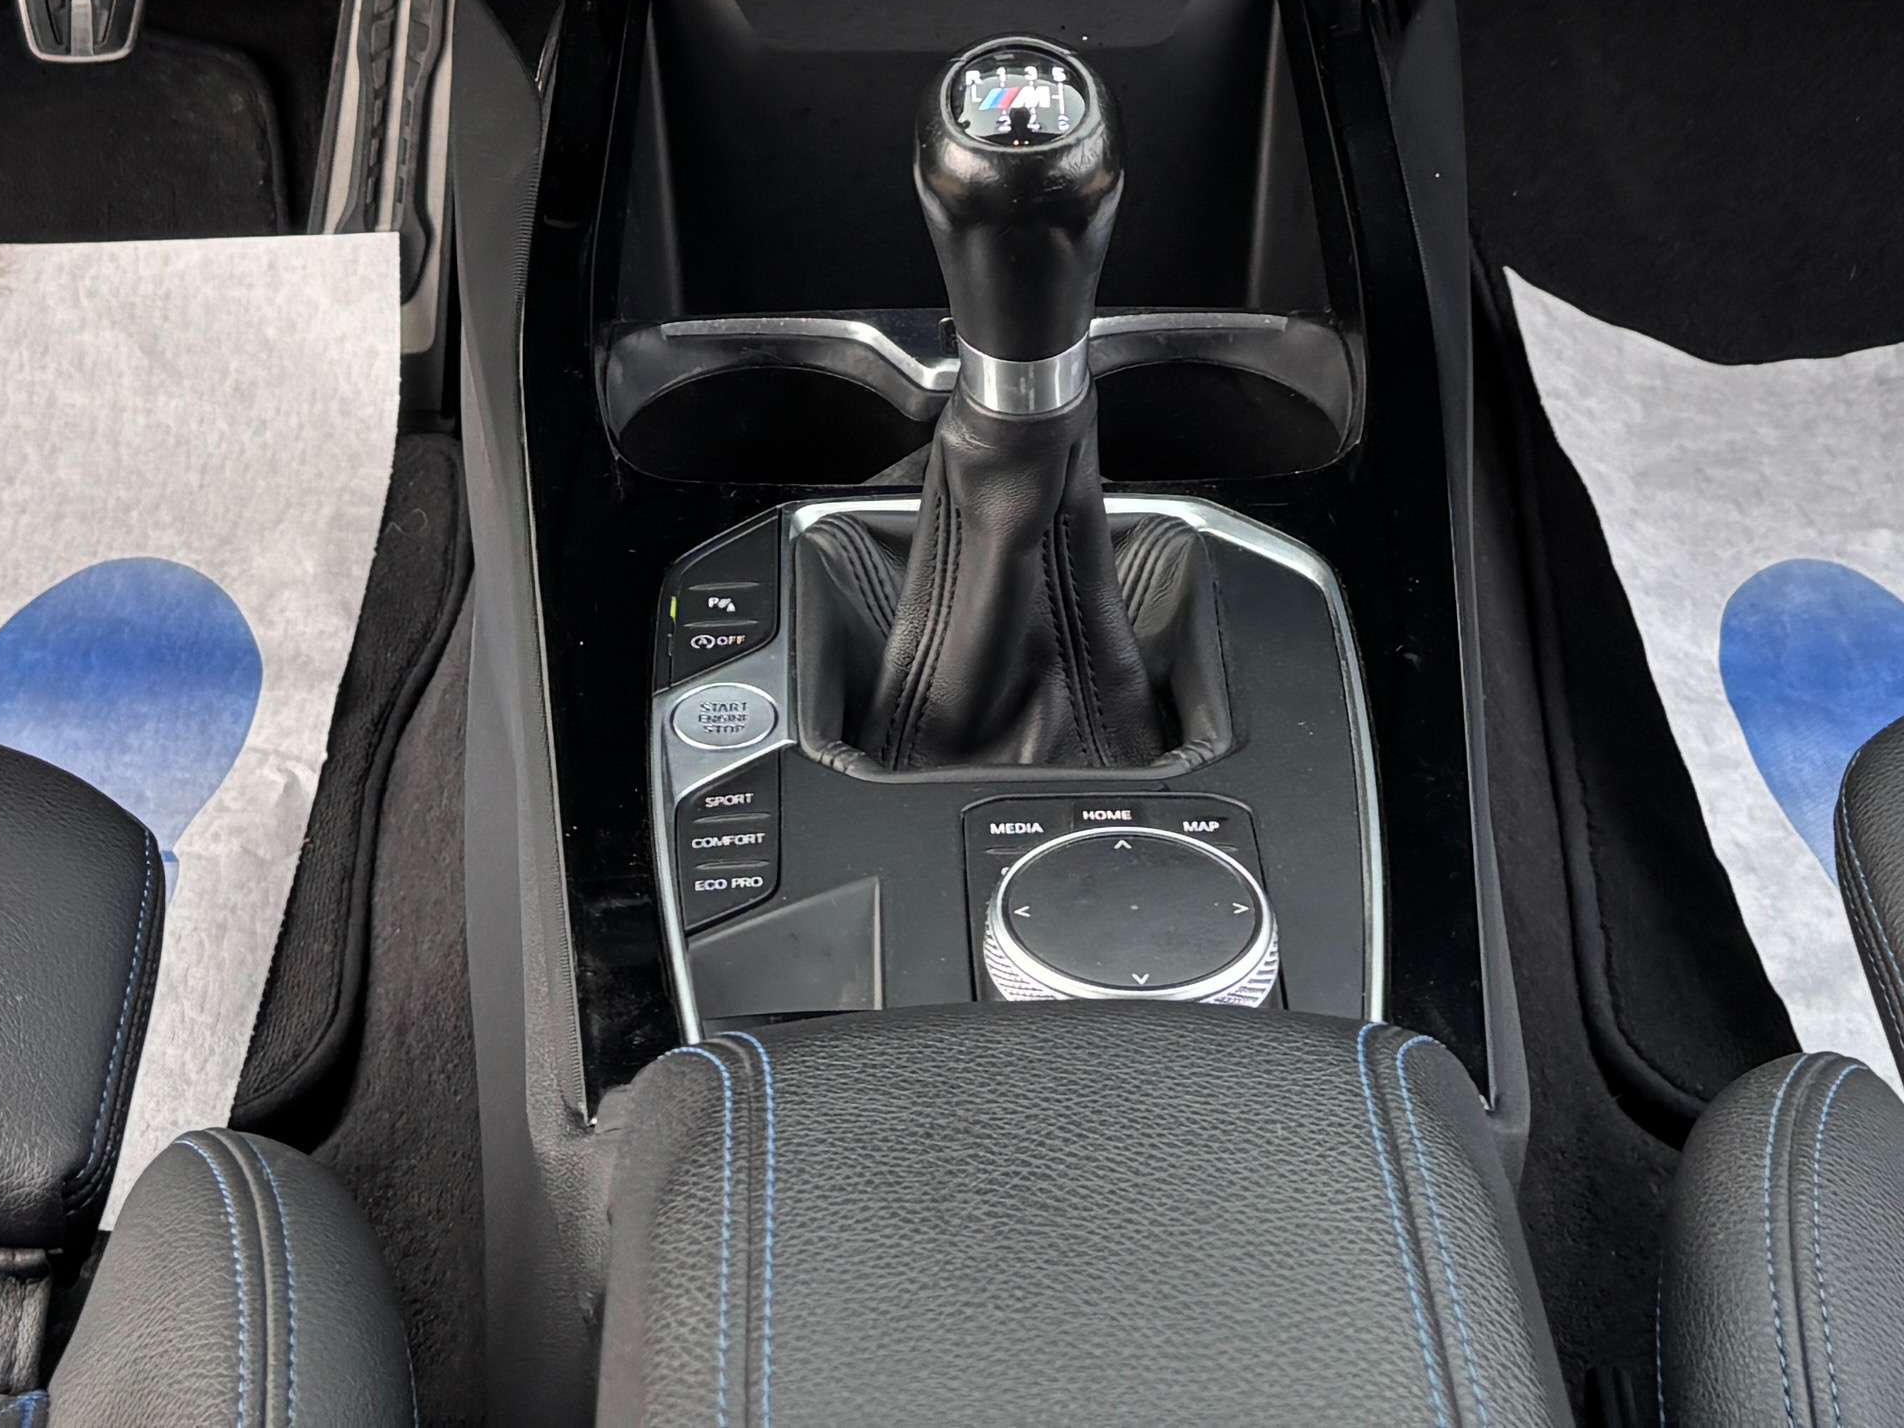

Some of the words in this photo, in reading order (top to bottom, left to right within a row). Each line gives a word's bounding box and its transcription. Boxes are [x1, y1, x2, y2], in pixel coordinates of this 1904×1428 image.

[1024, 66, 1038, 81] 3
[717, 635, 746, 646] OFF
[700, 702, 748, 713] START
[698, 713, 748, 723] ENGINE
[704, 725, 745, 735] STOP
[705, 793, 754, 808] SPORT
[1082, 810, 1133, 821] HOME
[990, 822, 1044, 835] MEDIA
[1182, 821, 1220, 833] MAP
[691, 833, 765, 849] COMFORT
[694, 879, 728, 891] ECO
[731, 876, 764, 888] PRO
